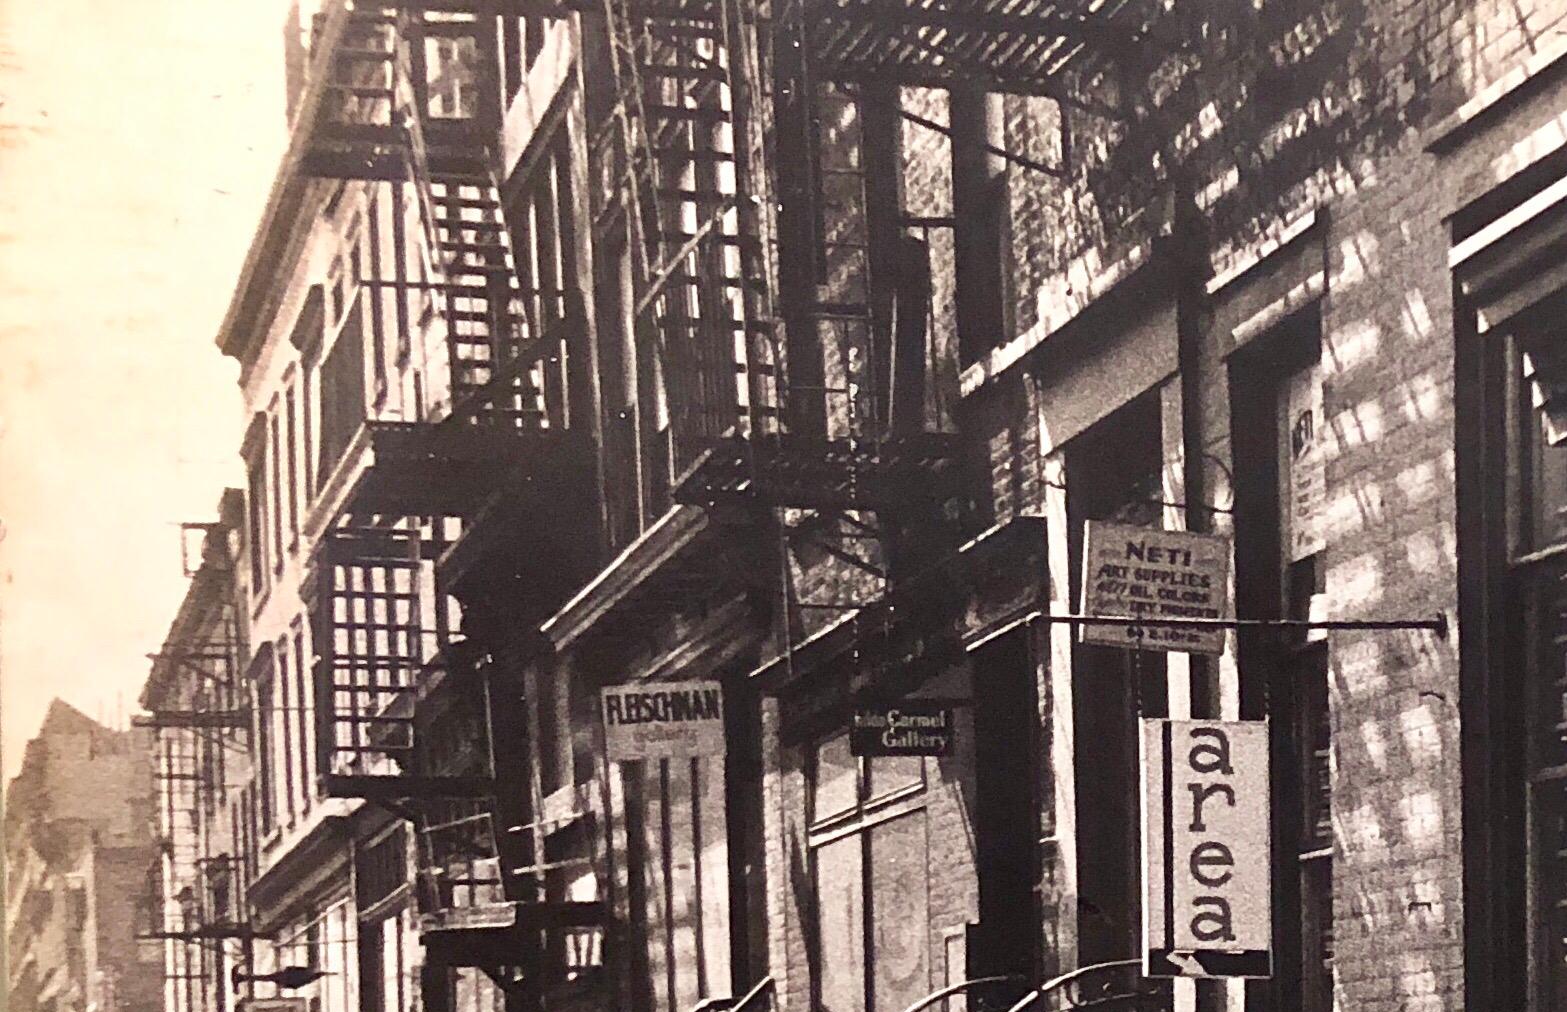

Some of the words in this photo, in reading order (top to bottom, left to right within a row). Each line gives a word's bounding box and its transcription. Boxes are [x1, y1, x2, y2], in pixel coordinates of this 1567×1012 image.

[1126, 540, 1192, 567] NETI
[1095, 563, 1128, 580] ART
[1134, 568, 1211, 588] SUPPLIES
[605, 689, 720, 725] FLEISCHMAN
[887, 709, 945, 728] Carmel
[881, 729, 947, 751] Gallery
[1187, 727, 1237, 942] area
